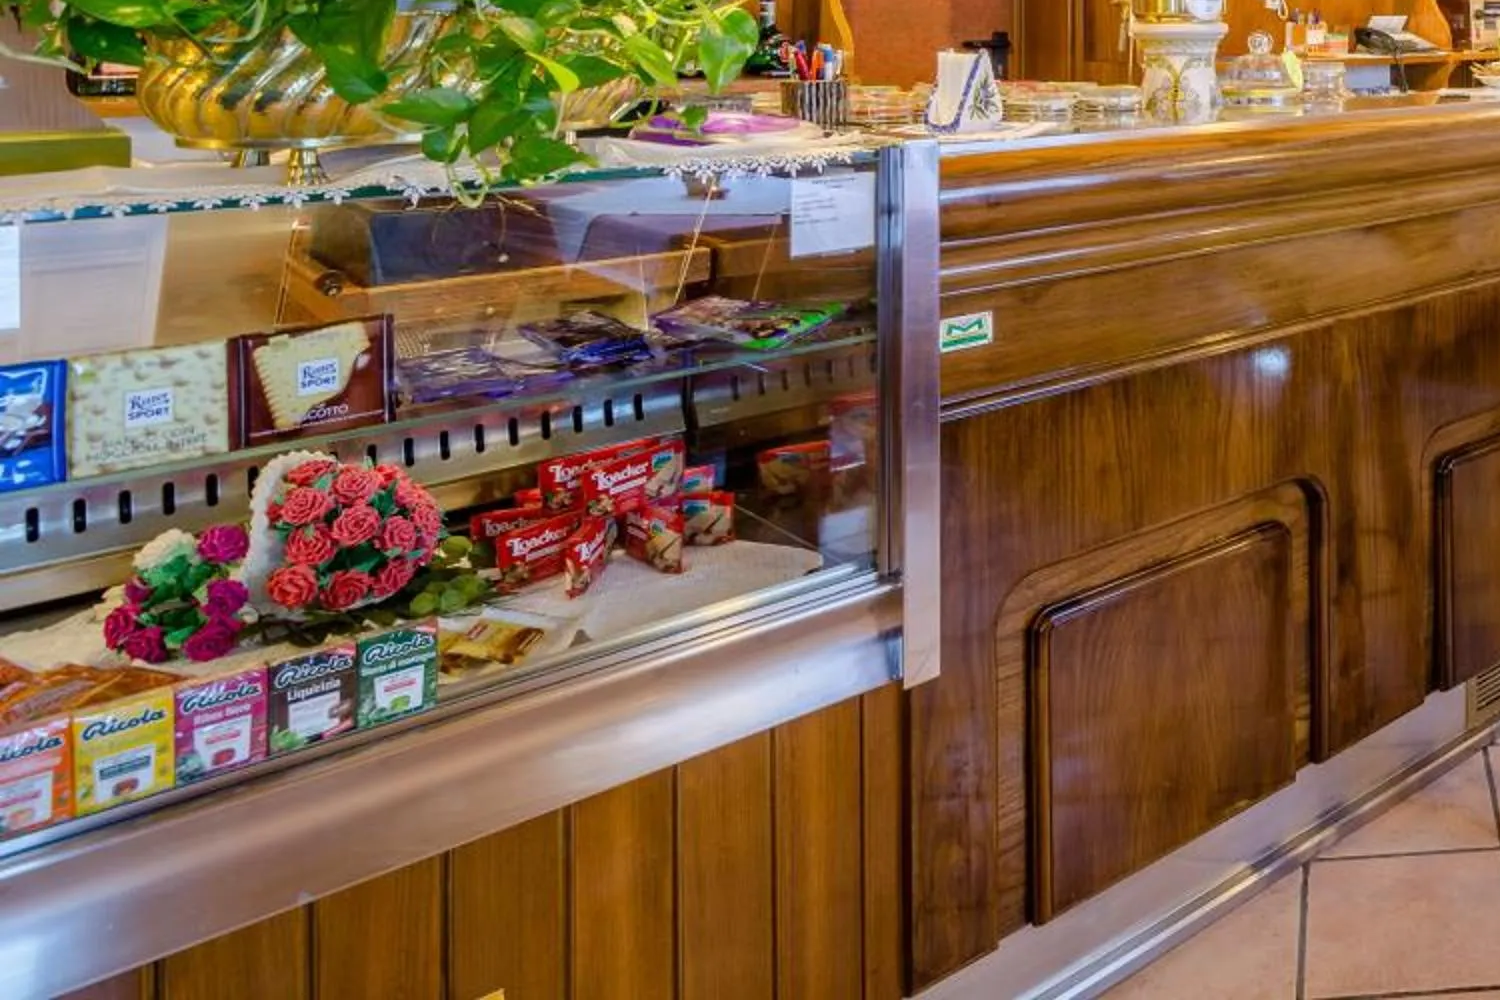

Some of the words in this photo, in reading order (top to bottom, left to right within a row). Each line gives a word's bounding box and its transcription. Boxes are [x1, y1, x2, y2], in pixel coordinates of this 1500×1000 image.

[300, 374, 338, 388] SPORT
[127, 407, 170, 421] SPORT
[364, 634, 434, 665] Ricola
[275, 654, 353, 688] Ricola
[183, 684, 261, 713] Ricola
[82, 709, 165, 741] Ricola
[0, 735, 63, 762] icola
